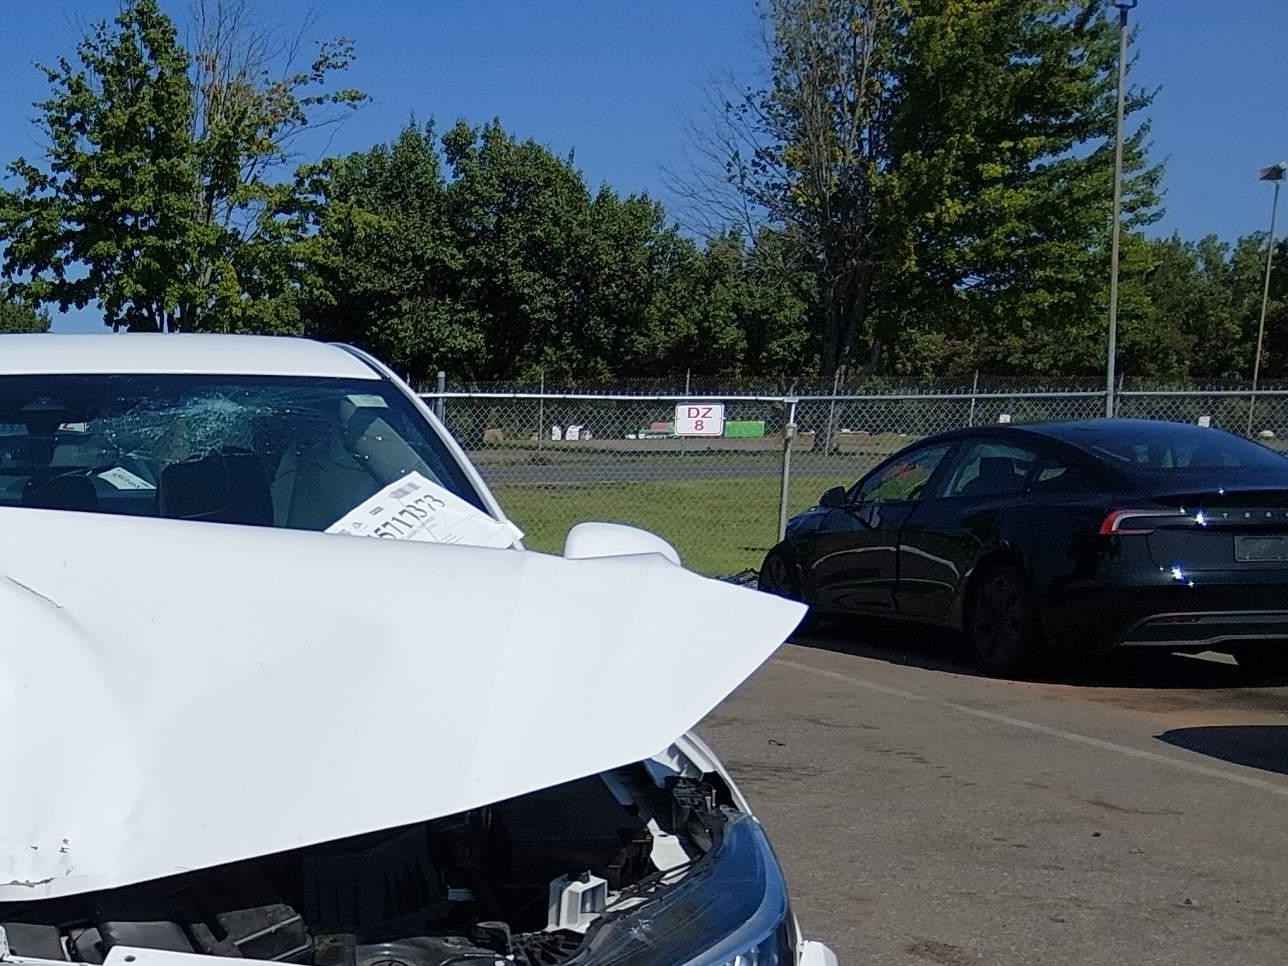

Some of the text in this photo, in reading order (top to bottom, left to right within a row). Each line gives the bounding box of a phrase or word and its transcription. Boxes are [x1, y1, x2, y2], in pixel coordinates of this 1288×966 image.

[687, 407, 713, 419] DZ
[695, 419, 705, 431] 8
[367, 494, 446, 541] 5717373
